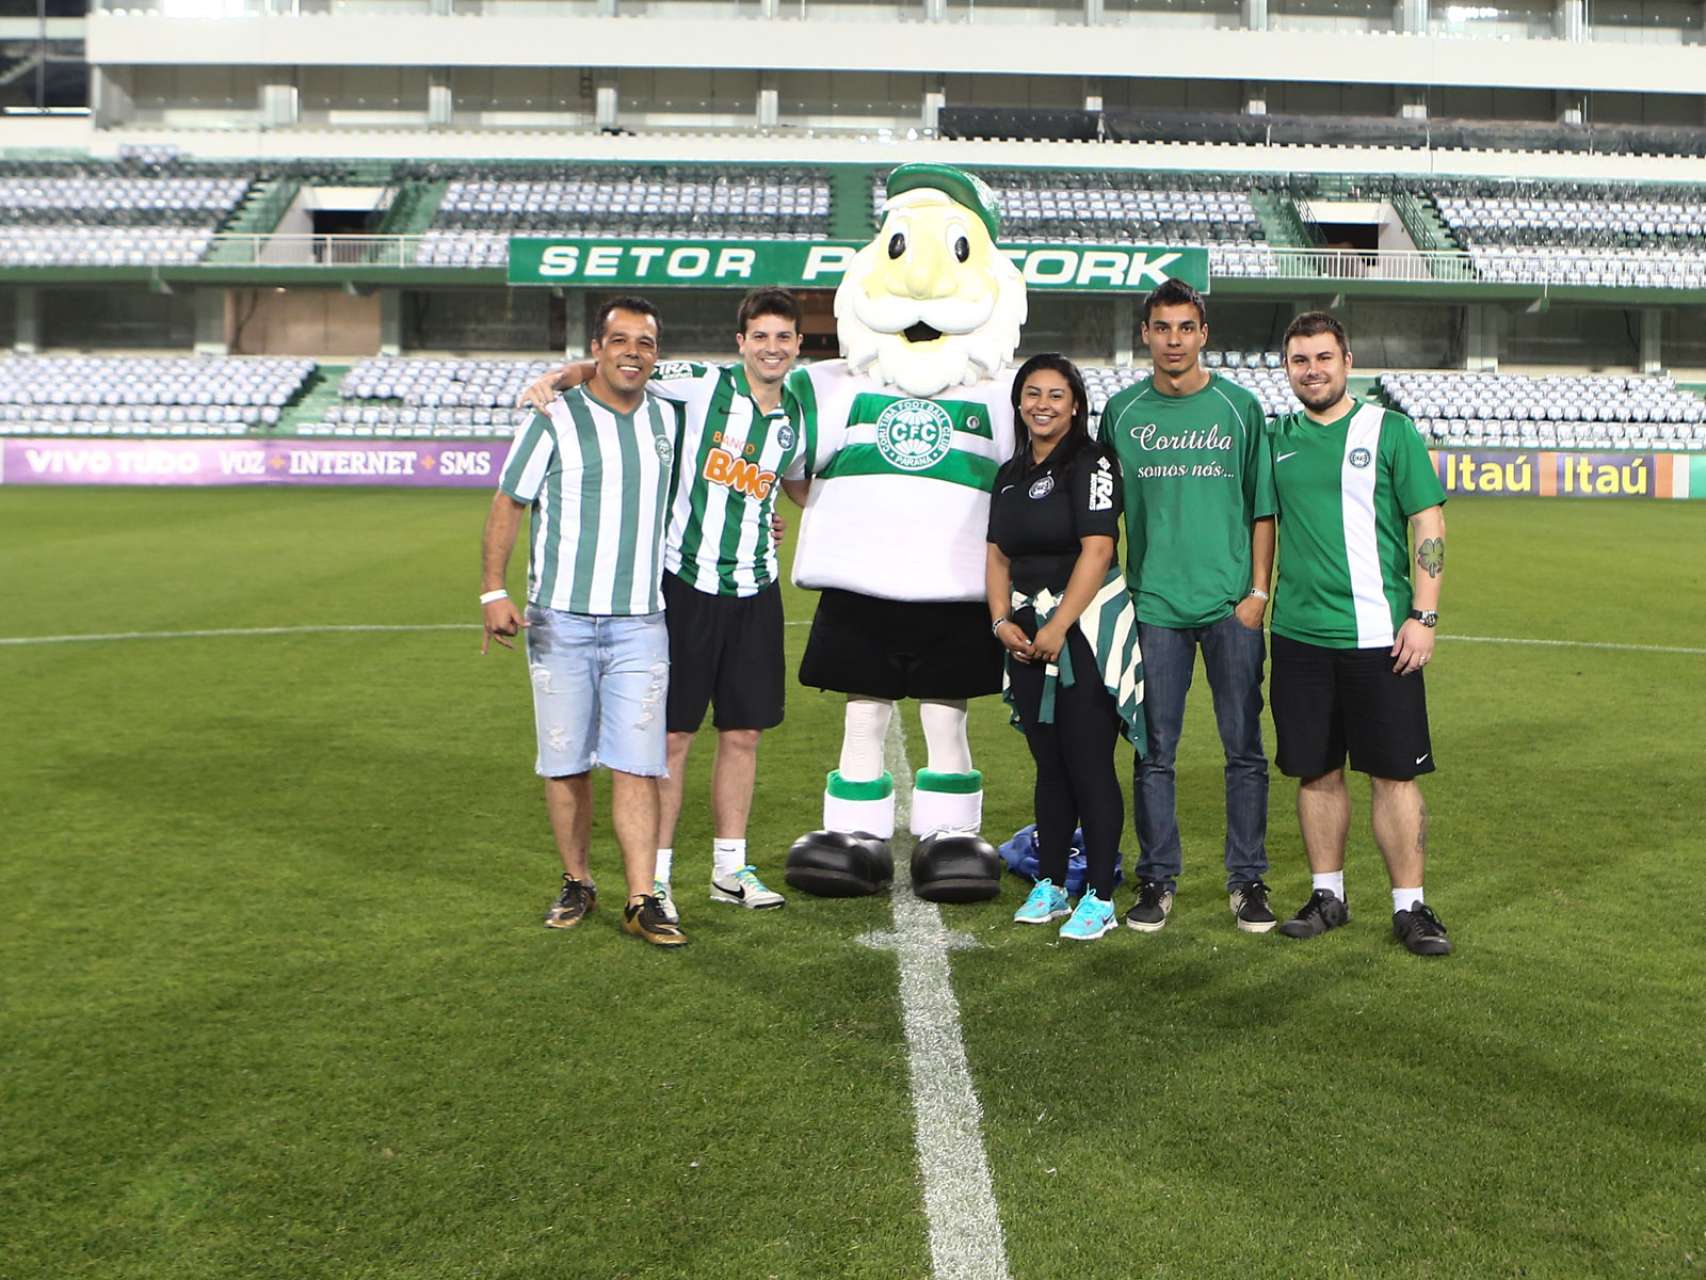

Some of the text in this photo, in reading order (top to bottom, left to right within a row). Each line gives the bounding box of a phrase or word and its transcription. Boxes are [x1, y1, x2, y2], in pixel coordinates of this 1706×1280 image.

[538, 246, 756, 277] SETOR
[892, 423, 937, 441] CFC
[1130, 423, 1233, 451] Coritiba
[25, 449, 111, 474] VIVO
[218, 451, 266, 475] VOZ
[288, 451, 418, 475] INTERNET
[439, 451, 491, 475] SMS
[703, 448, 777, 501] BMG
[1137, 463, 1189, 478] somos
[1446, 454, 1648, 494] Itaú Itaú
